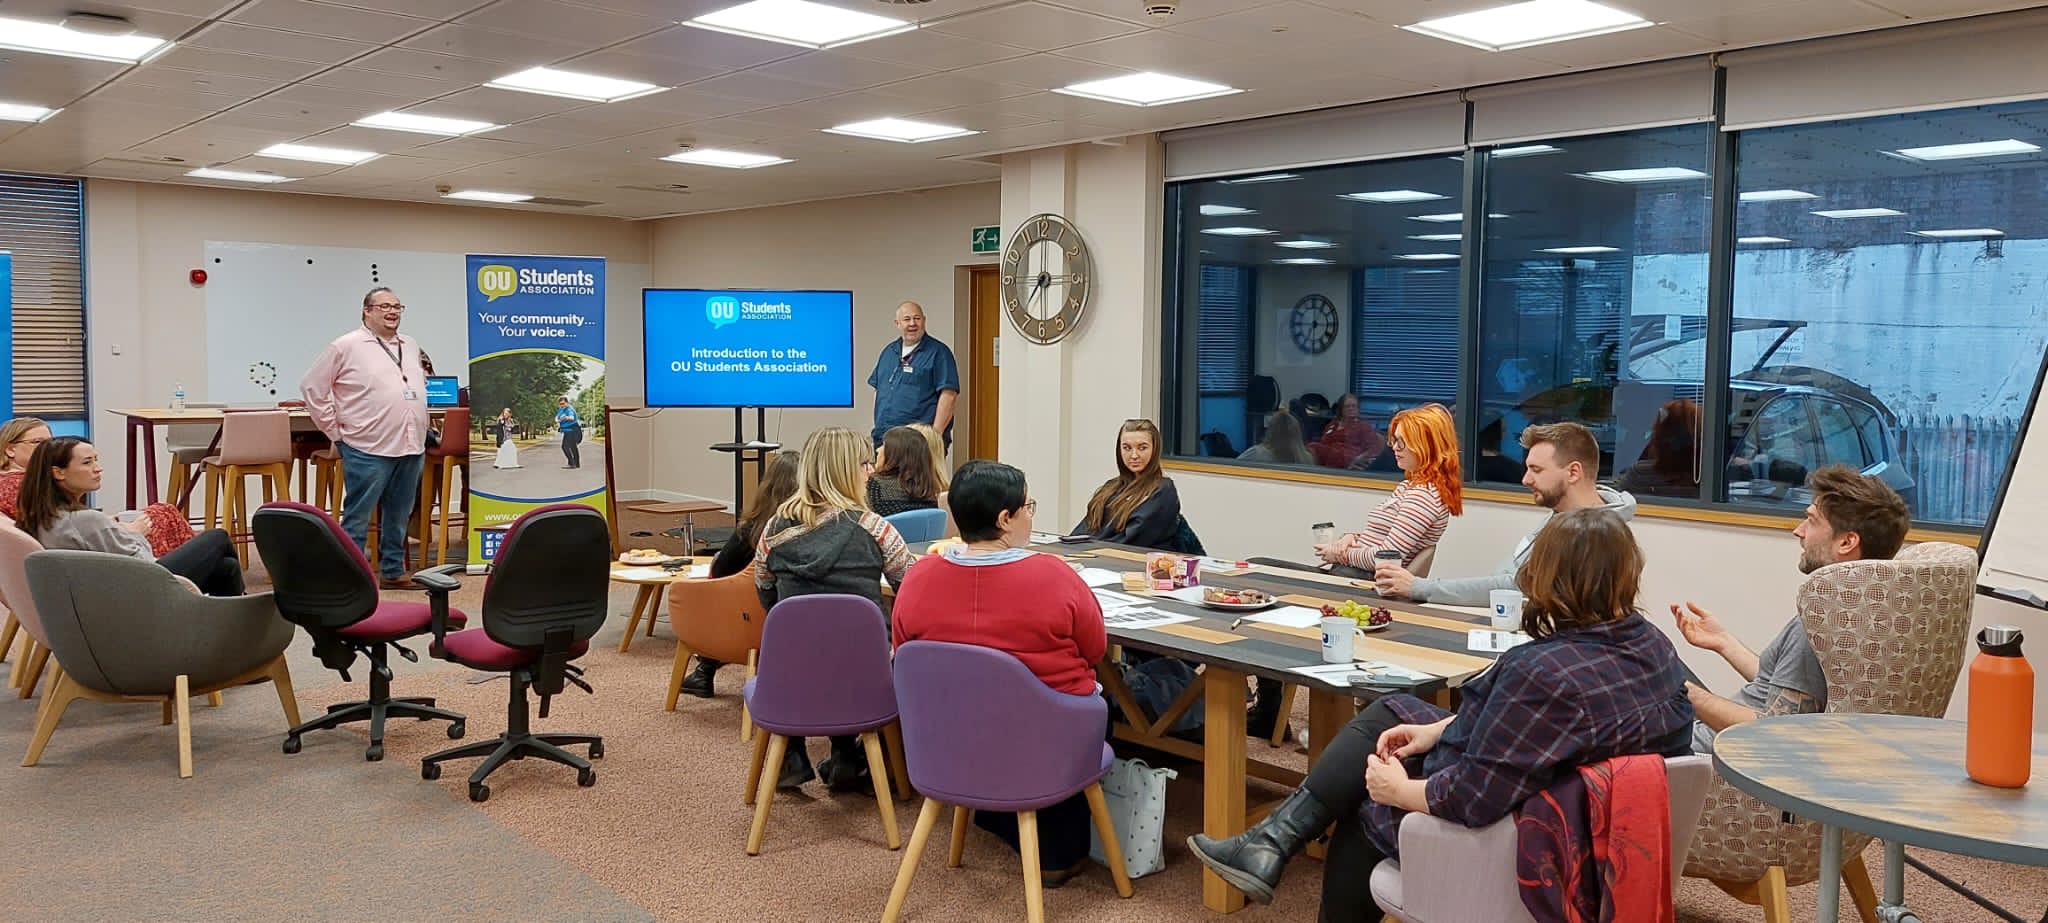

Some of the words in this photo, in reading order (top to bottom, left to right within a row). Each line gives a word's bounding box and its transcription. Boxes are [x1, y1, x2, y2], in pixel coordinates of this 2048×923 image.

[483, 270, 511, 291] OU
[519, 268, 594, 286] Students
[519, 286, 595, 295] ASSOCIATION
[711, 302, 733, 319] OU
[741, 301, 792, 314] Students
[478, 312, 507, 324] Your
[510, 313, 595, 327] community...
[498, 326, 527, 337] Your
[530, 327, 577, 338] voice...
[691, 347, 768, 359] Introduction
[771, 348, 784, 359] to
[787, 348, 807, 359] the
[671, 361, 691, 372] OU
[694, 361, 750, 372] Students
[753, 362, 828, 373] Association
